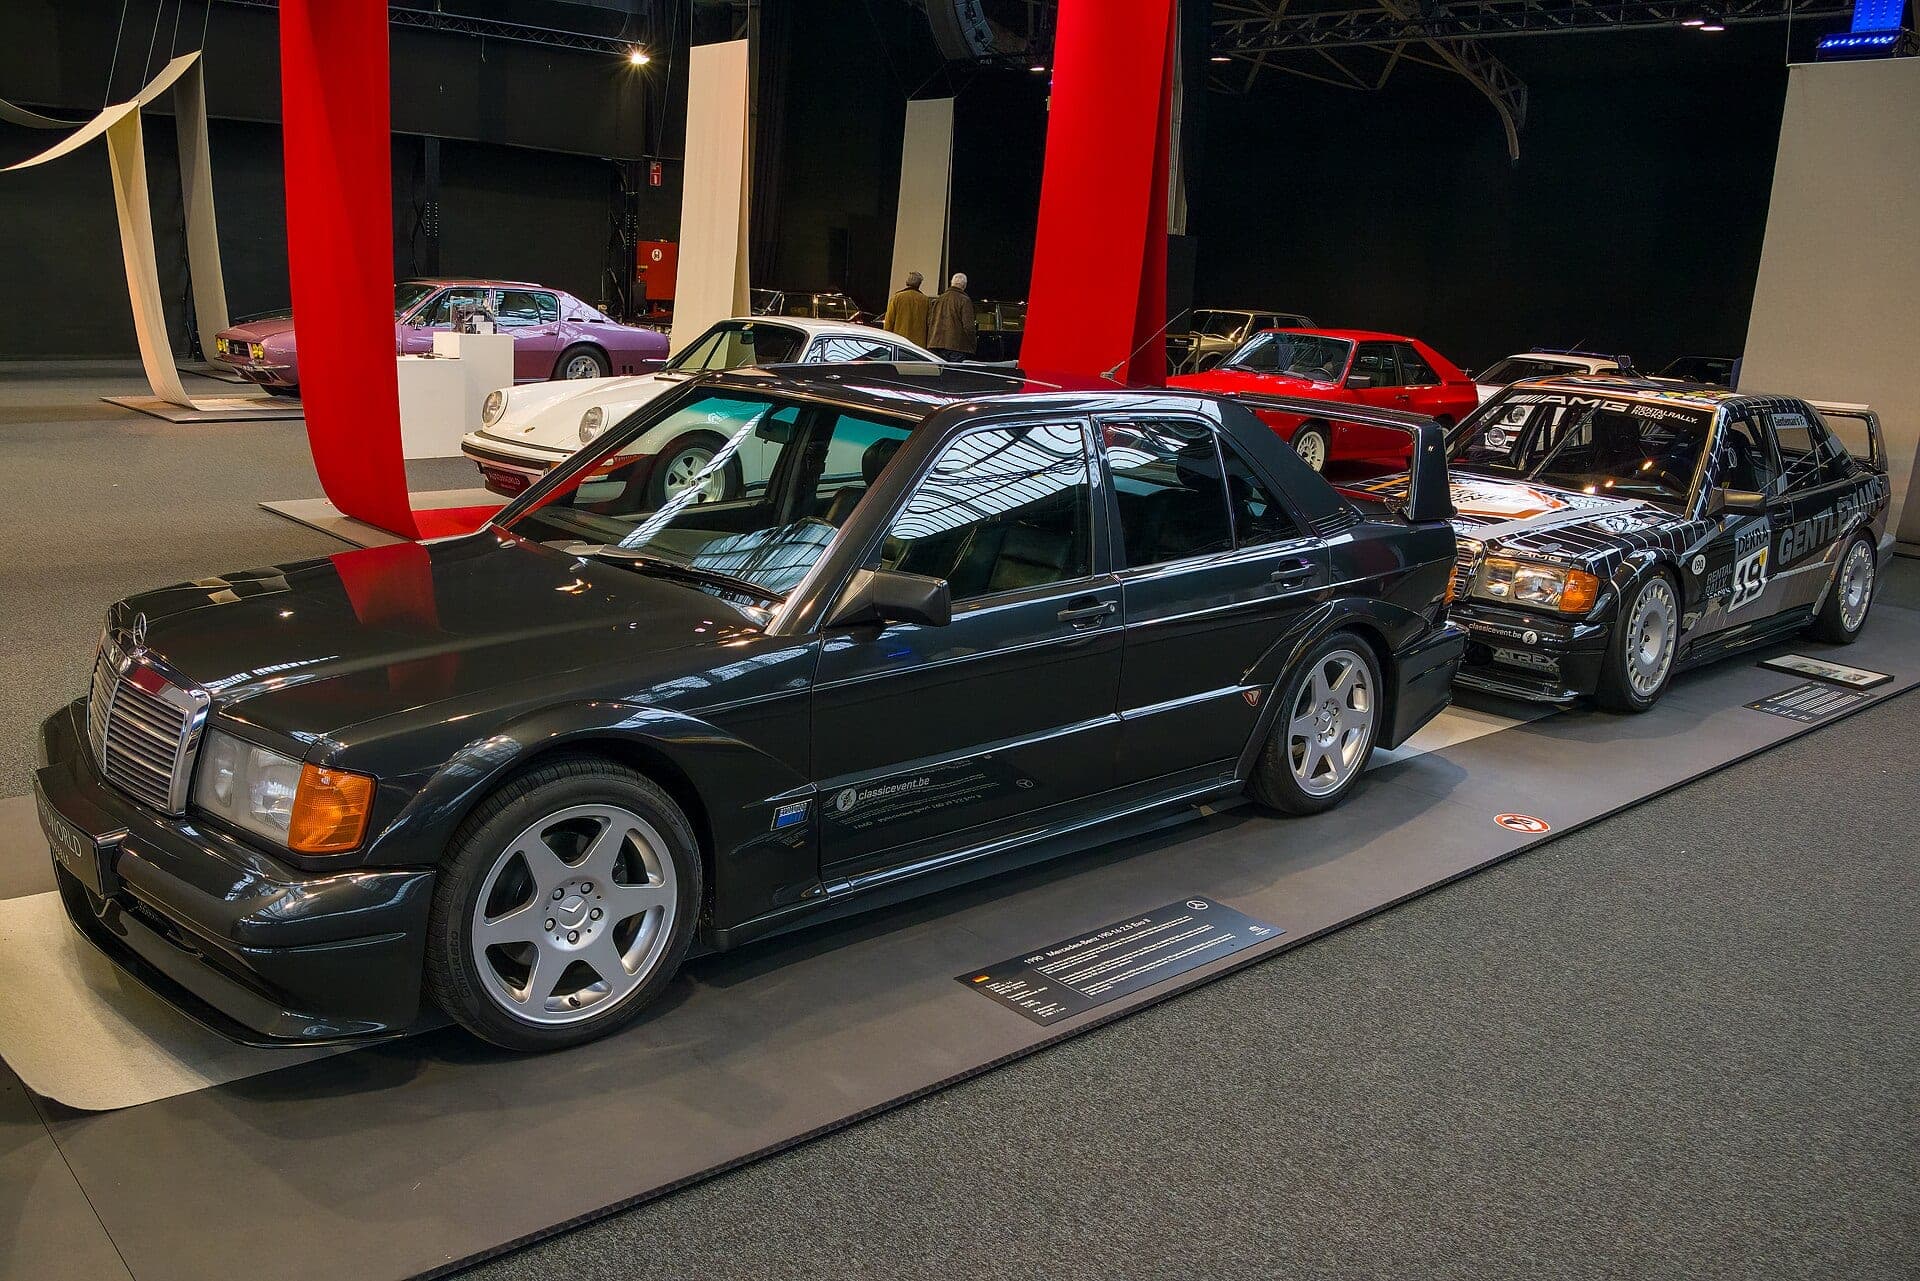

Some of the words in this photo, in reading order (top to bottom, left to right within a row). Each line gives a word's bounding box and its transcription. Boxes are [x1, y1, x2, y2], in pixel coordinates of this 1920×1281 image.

[1537, 394, 1630, 413] AMG
[1737, 523, 1769, 556] DEKRA
[1519, 550, 1562, 563] AMG
[1706, 562, 1733, 586] RENTAL
[1468, 622, 1522, 639] classicevent.be
[858, 776, 930, 801] classicevent.be
